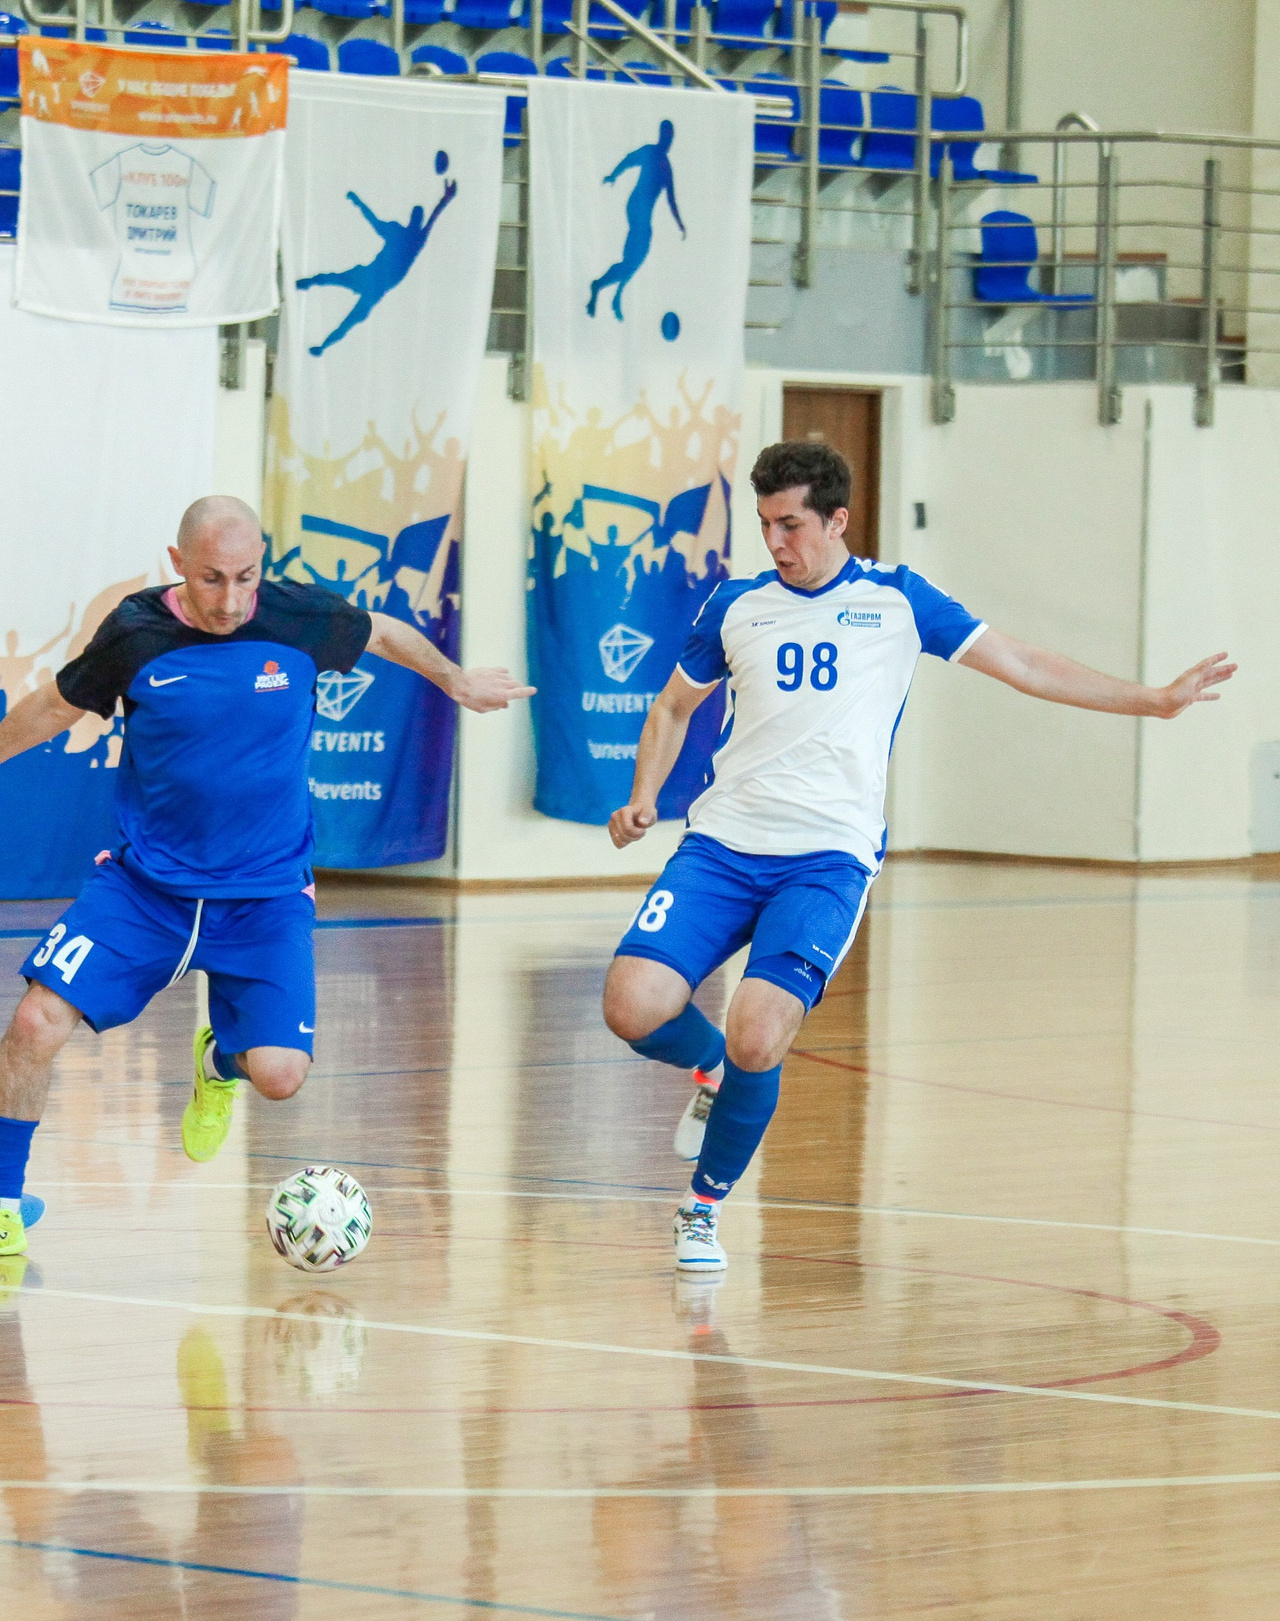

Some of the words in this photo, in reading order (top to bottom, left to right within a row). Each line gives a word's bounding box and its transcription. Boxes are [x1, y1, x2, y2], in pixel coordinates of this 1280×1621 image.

[126, 203, 177, 220] ТОКАРЕВ
[850, 612, 882, 621] ГАЗПРОМ
[776, 641, 838, 692] 98
[582, 691, 661, 713] UNEVENT
[33, 923, 95, 985] 34
